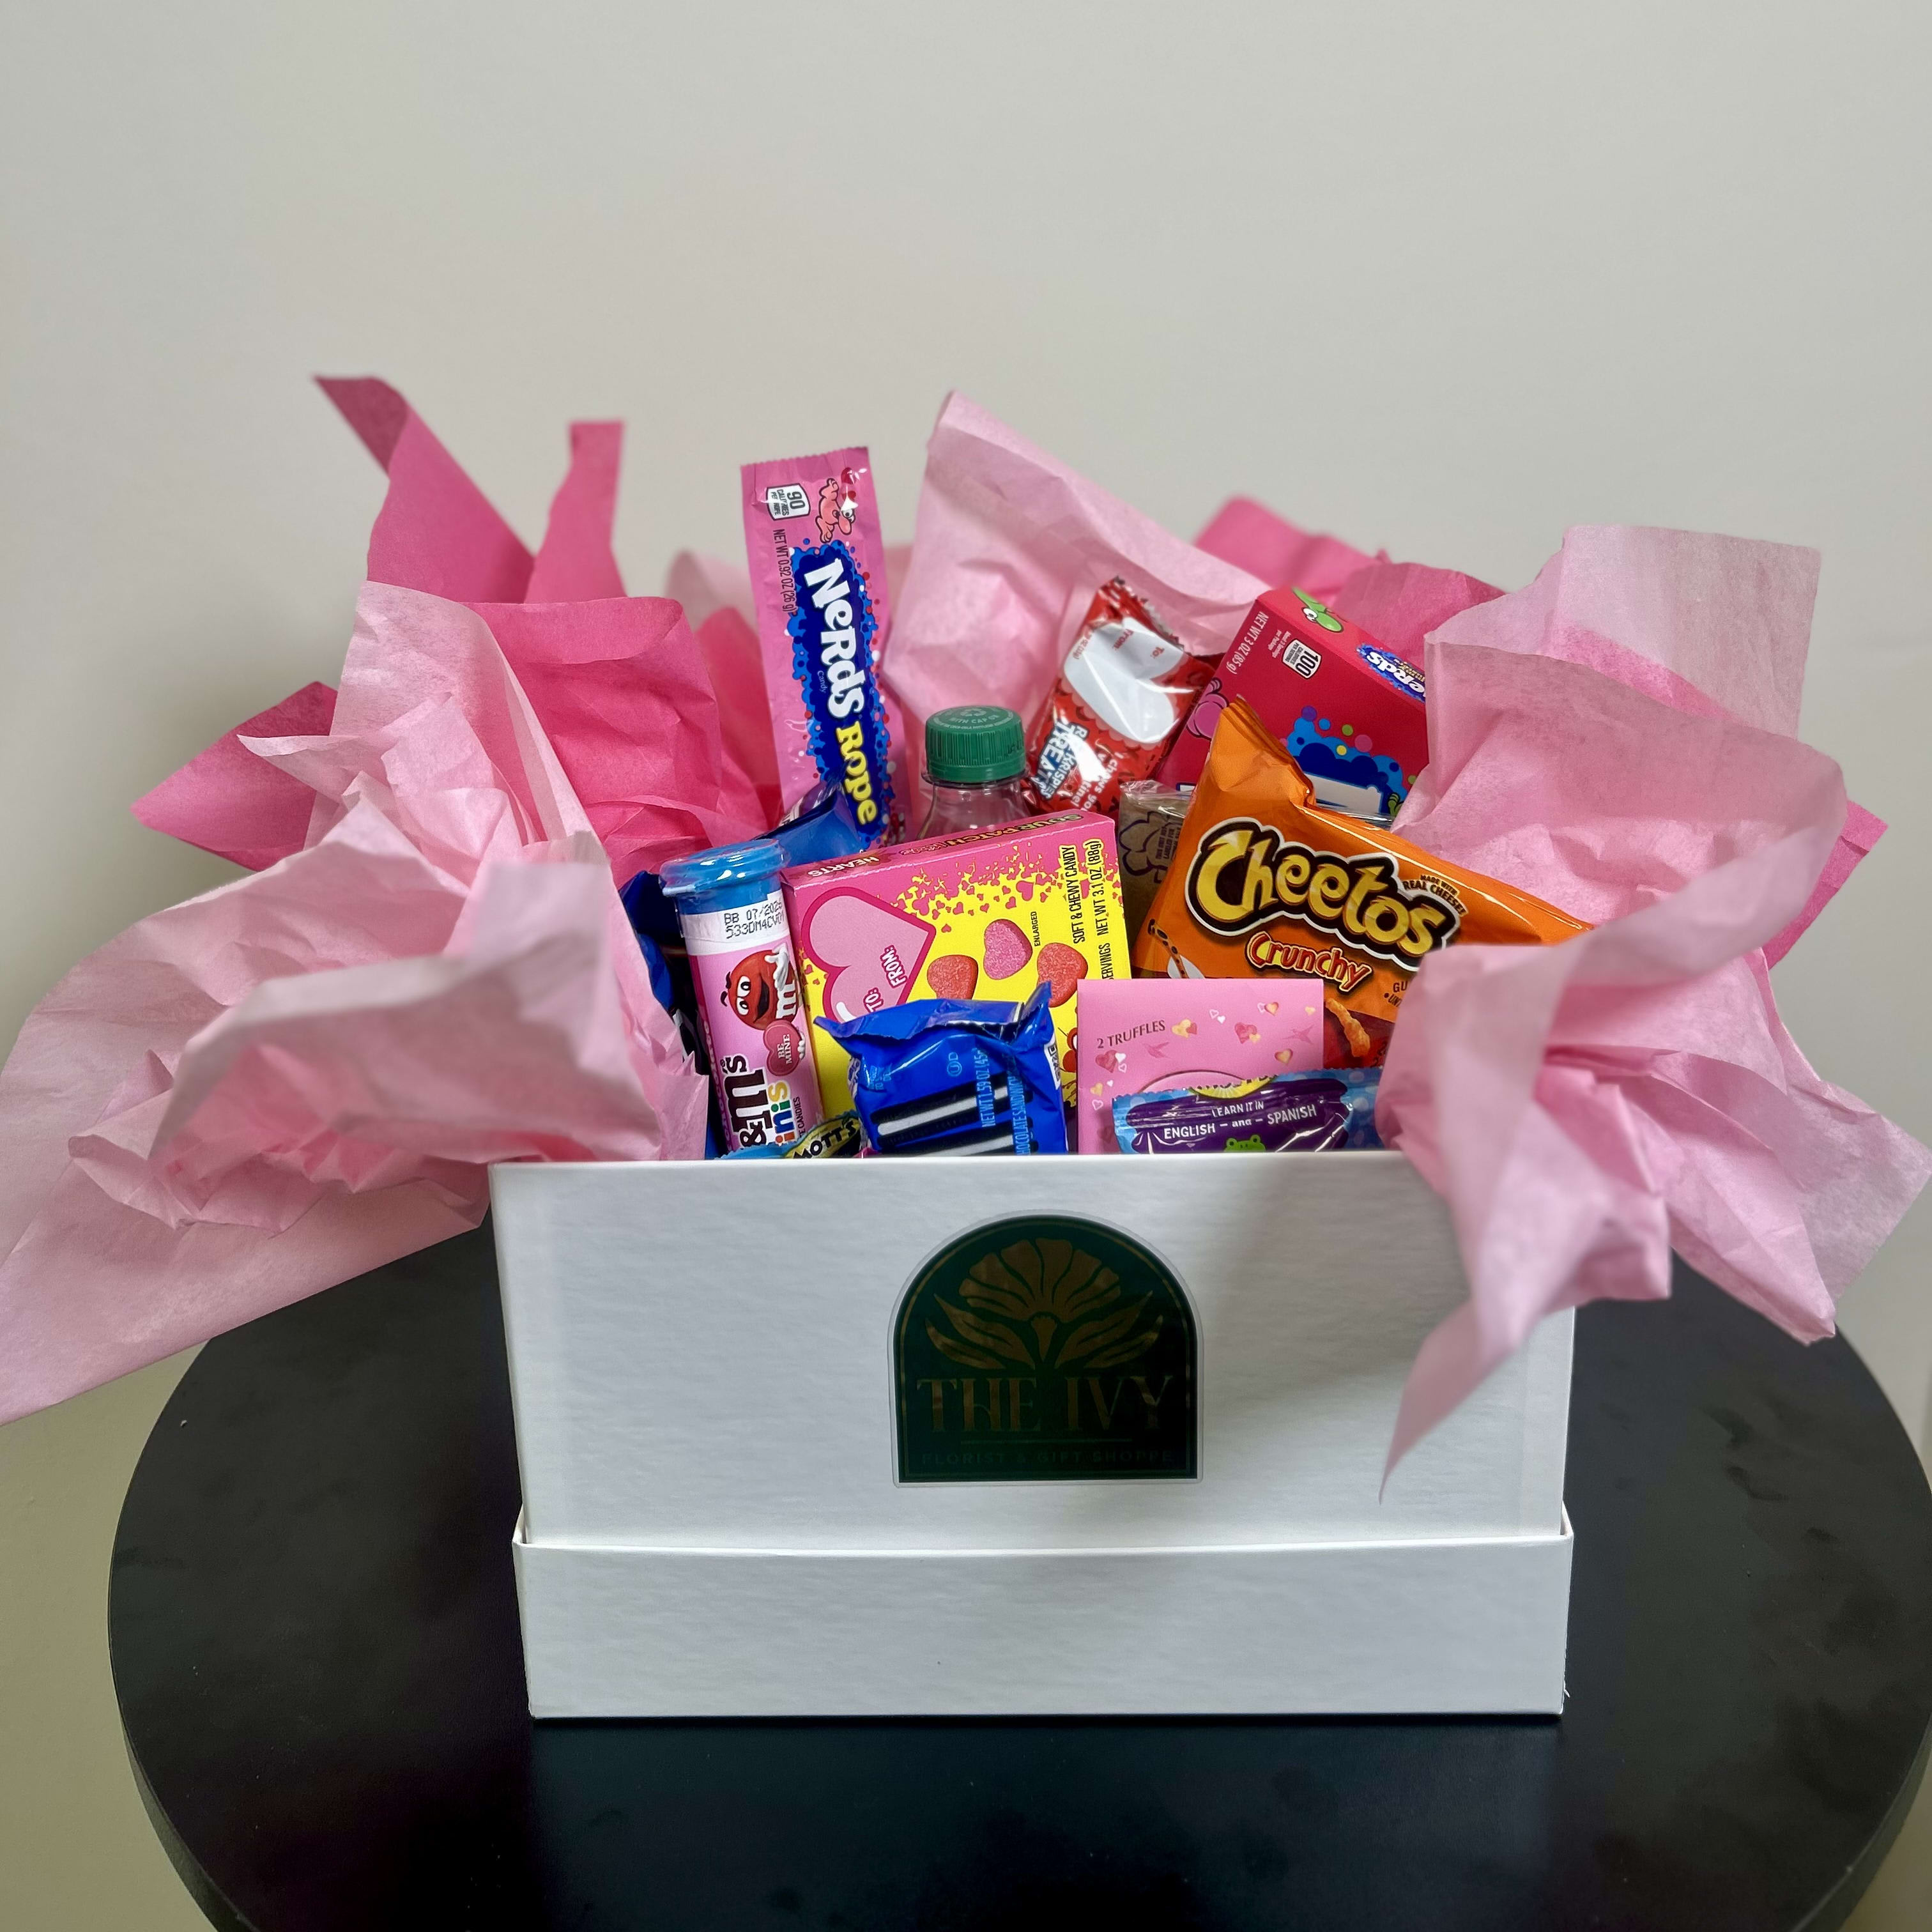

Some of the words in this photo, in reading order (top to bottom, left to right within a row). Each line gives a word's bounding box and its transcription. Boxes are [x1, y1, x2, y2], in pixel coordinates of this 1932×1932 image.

[786, 491, 806, 509] 90
[772, 528, 786, 544] NET
[776, 545, 789, 557] WT
[778, 559, 791, 577] 0.92
[781, 578, 794, 589] OZ
[780, 590, 795, 602] (26
[782, 604, 797, 612] g)
[1254, 611, 1269, 629] NET
[1243, 636, 1254, 645] 3
[1246, 626, 1262, 641] WT
[1238, 642, 1251, 656] OZ
[1289, 646, 1303, 665] CALORIES
[1225, 661, 1238, 675] g)
[1231, 651, 1246, 667] (85
[1295, 650, 1319, 677] 100
[816, 670, 826, 694] Candy
[1020, 814, 1083, 833] SOUR
[946, 827, 1018, 847] PATCH
[1085, 840, 1102, 866] (88g)
[808, 856, 880, 877] HEARTS
[1061, 847, 1078, 878] CANDY
[1089, 866, 1103, 881] OZ
[1420, 875, 1440, 884] MADE
[1092, 882, 1105, 897] 3.1
[1195, 829, 1433, 956] Cheetos
[1402, 880, 1427, 890] REAL
[1066, 878, 1082, 912] CHEWY
[1070, 911, 1083, 921] &
[1093, 898, 1107, 916] WT
[724, 912, 739, 925] BB
[1095, 917, 1109, 937] NET
[1030, 910, 1041, 947] ENLARGED
[1071, 921, 1085, 944] SOFT
[882, 946, 907, 986] FROM:
[1248, 933, 1371, 991] Crunchy
[865, 989, 882, 1013] TO:
[1097, 1038, 1103, 1048] 2
[1107, 1020, 1166, 1046] TRUFFLES
[777, 1043, 786, 1059] BE
[783, 1034, 793, 1064] MINE
[976, 1068, 990, 1080] OZ
[793, 1096, 805, 1131] CANDIES
[979, 1100, 994, 1113] WT
[1212, 1103, 1243, 1117] LEARN
[1245, 1101, 1253, 1112] IT
[1255, 1100, 1264, 1110] IN
[981, 1112, 996, 1128] NET
[1164, 1123, 1216, 1139] ENGLISH
[1267, 1104, 1317, 1126] SPANISH
[1013, 1116, 1032, 1155] HOCOLATE
[916, 1376, 1042, 1433] THE
[1064, 1374, 1174, 1432] IVY
[921, 1450, 1006, 1466] FLORIST
[1036, 1450, 1082, 1464] GIFT
[1092, 1448, 1175, 1463] SHOPPE
